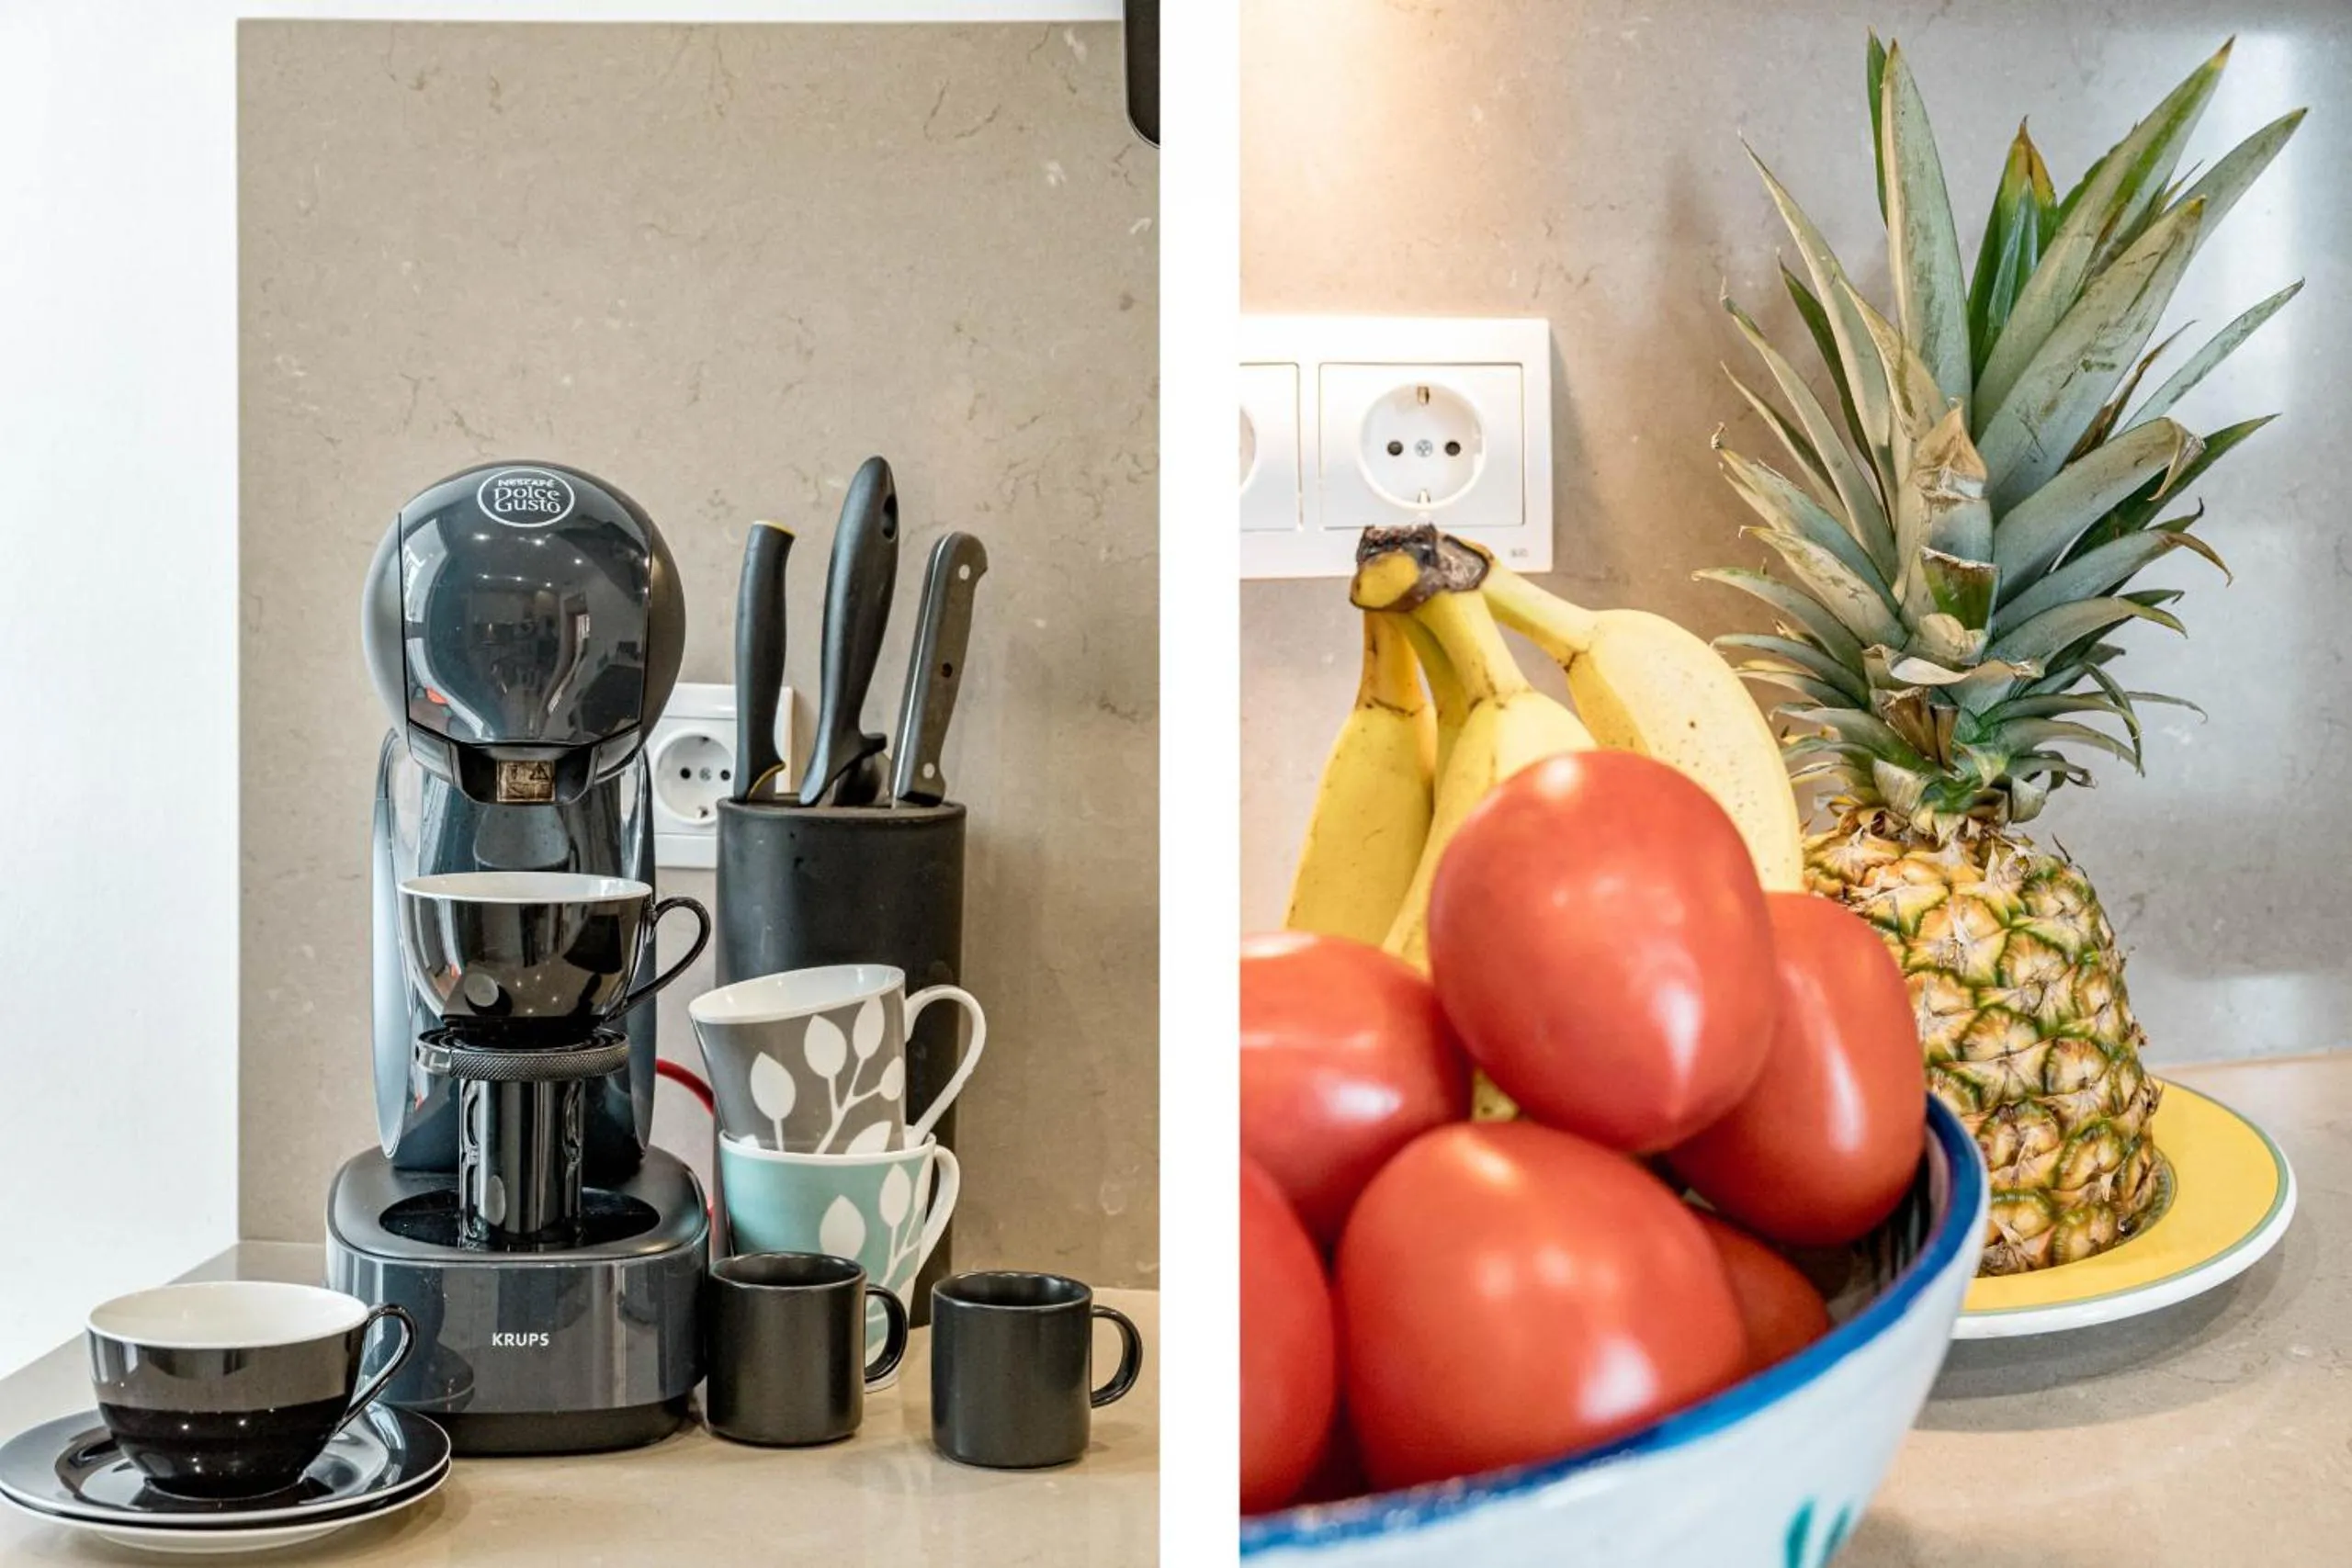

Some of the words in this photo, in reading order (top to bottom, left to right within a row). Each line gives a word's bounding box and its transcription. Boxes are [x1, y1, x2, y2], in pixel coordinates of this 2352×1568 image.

[494, 486, 560, 502] Dolce
[494, 499, 560, 513] Gusto
[492, 1332, 549, 1347] KRUPS
